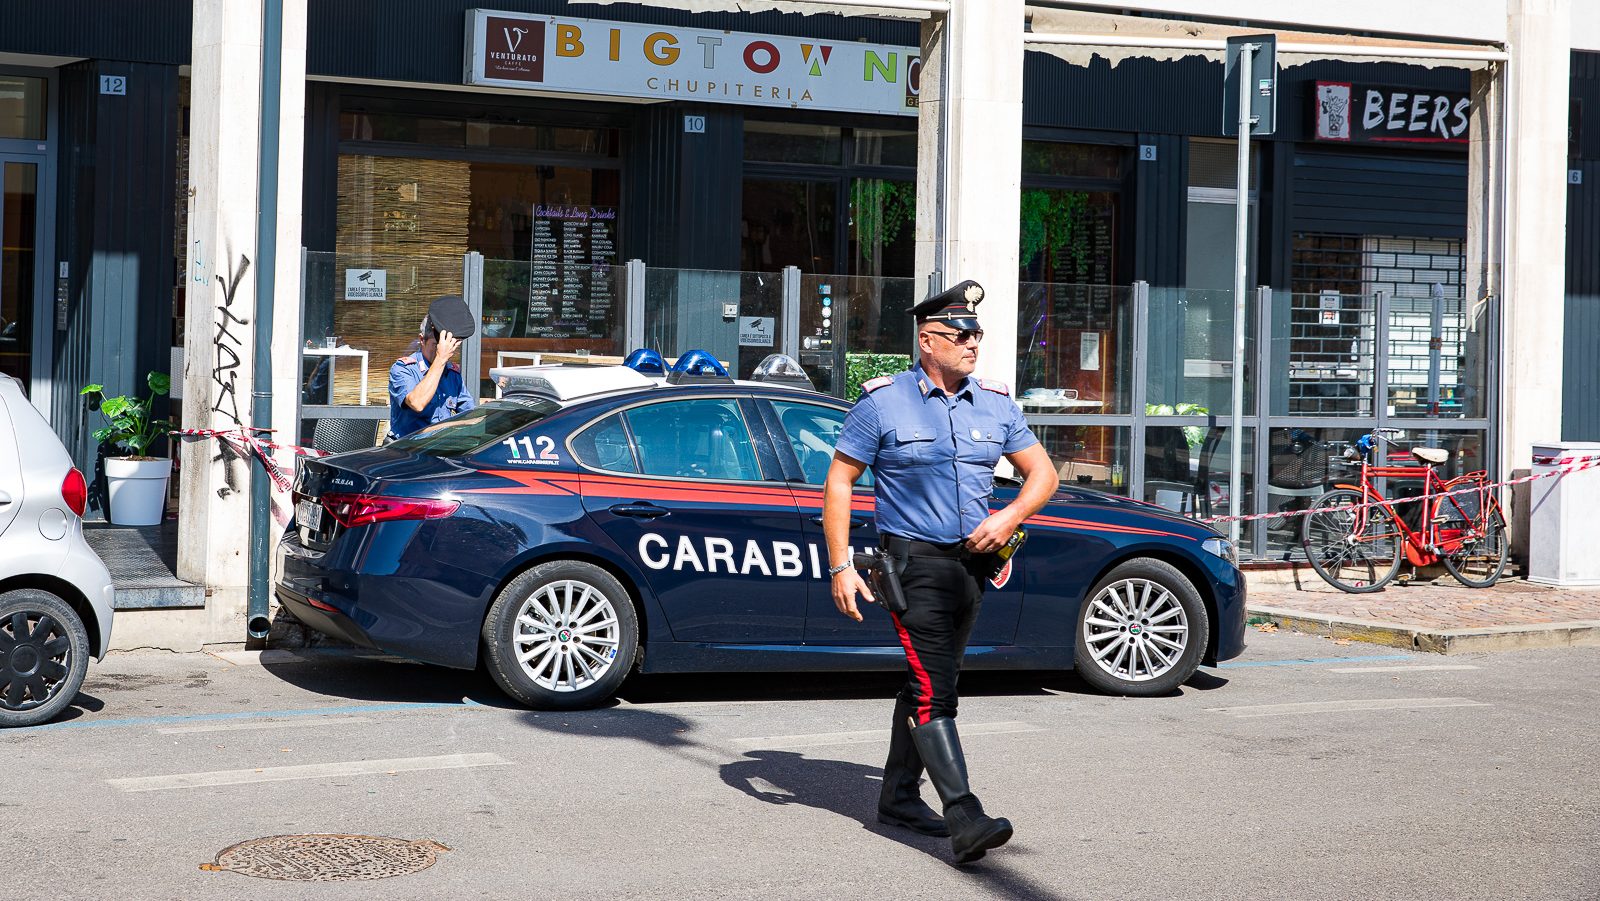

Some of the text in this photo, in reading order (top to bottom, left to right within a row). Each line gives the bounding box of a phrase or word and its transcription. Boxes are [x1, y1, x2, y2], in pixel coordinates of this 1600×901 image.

[490, 51, 537, 62] VENTURATO
[104, 77, 122, 92] 12
[647, 77, 813, 101] CHUPITERIA
[1363, 89, 1470, 139] BEERS
[688, 117, 704, 130] 10
[1146, 147, 1152, 158] 8
[1572, 172, 1578, 182] 6
[536, 205, 563, 218] Cocktails
[570, 206, 588, 222] Long
[590, 208, 616, 219] Drinks
[503, 435, 559, 460] 112
[638, 532, 874, 579] CARABI
